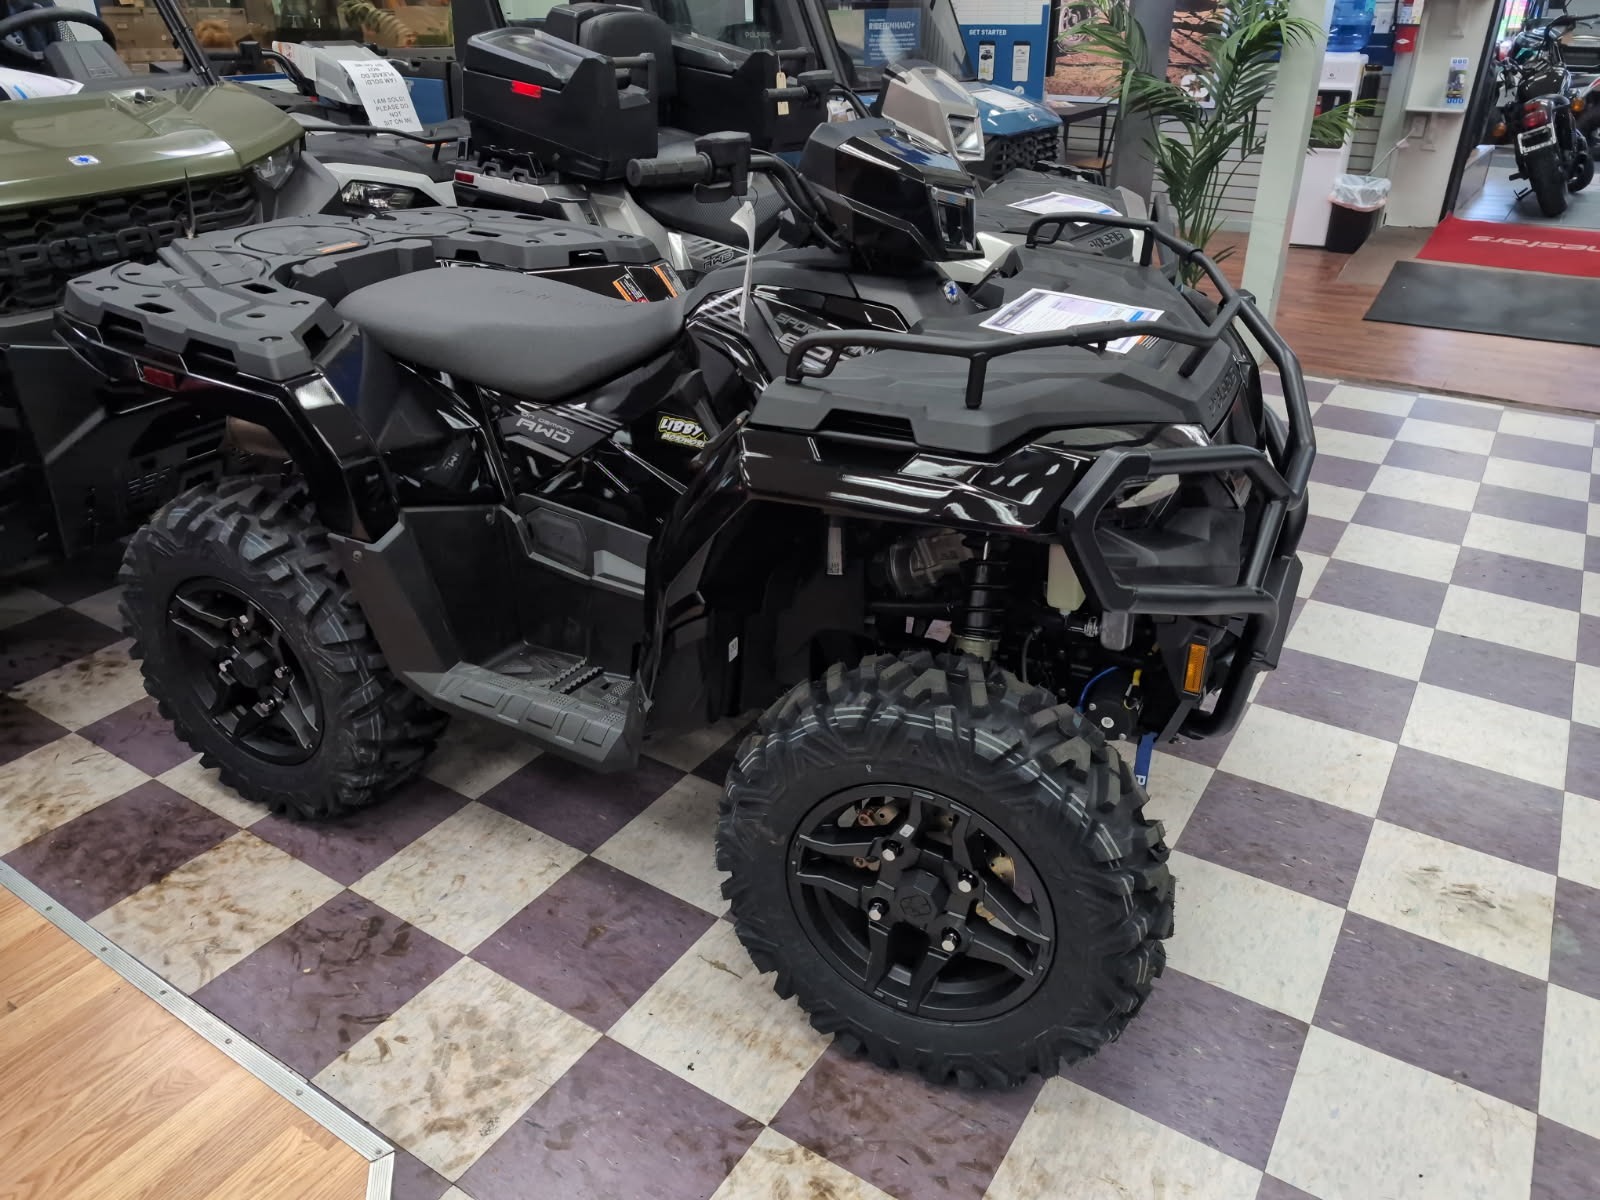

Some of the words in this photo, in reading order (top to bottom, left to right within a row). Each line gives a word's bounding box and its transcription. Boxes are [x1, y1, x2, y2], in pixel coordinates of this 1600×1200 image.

[515, 417, 571, 444] AWD
[537, 417, 575, 435] DEMAND
[660, 418, 703, 437] LIBBY
